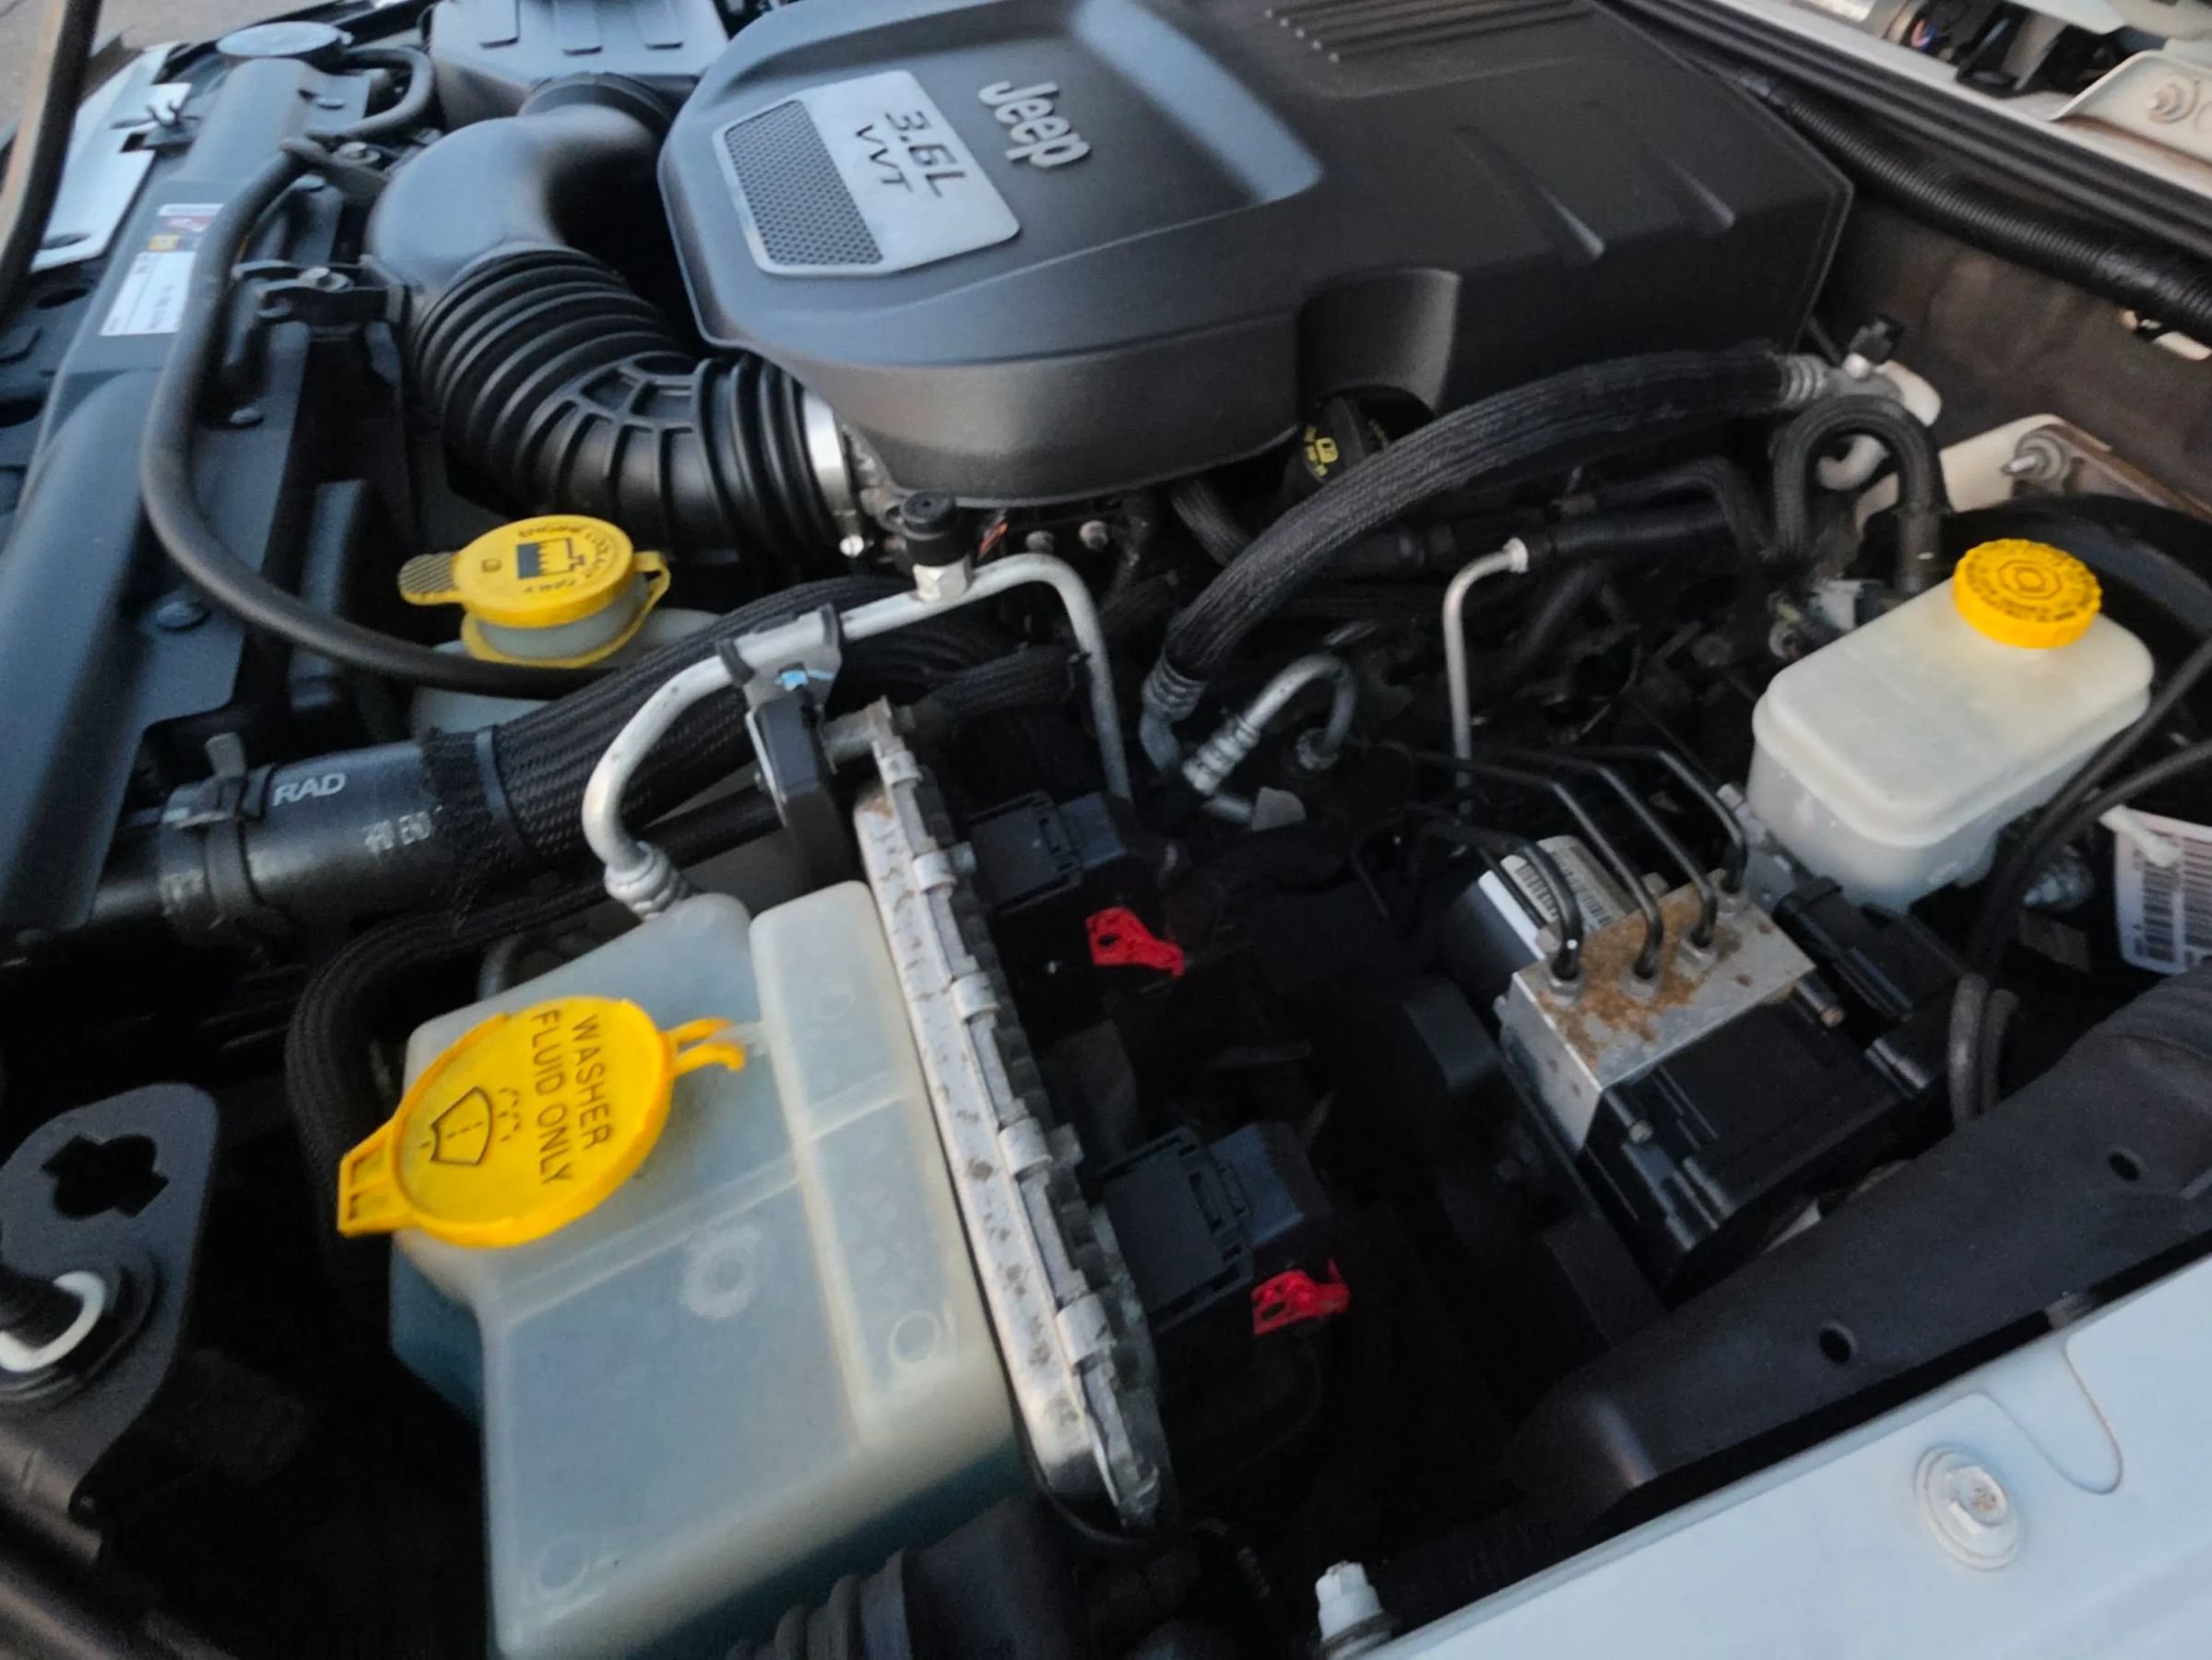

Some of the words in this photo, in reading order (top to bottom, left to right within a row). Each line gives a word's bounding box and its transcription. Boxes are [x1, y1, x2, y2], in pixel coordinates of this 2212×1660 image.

[856, 124, 913, 193] VVT
[885, 110, 966, 198] 3.6L
[977, 80, 1091, 168] Jeep
[273, 772, 347, 807] RAD
[530, 1008, 566, 1097] FLUID
[571, 1014, 614, 1152] WASHER
[536, 1102, 574, 1186] ONLY
